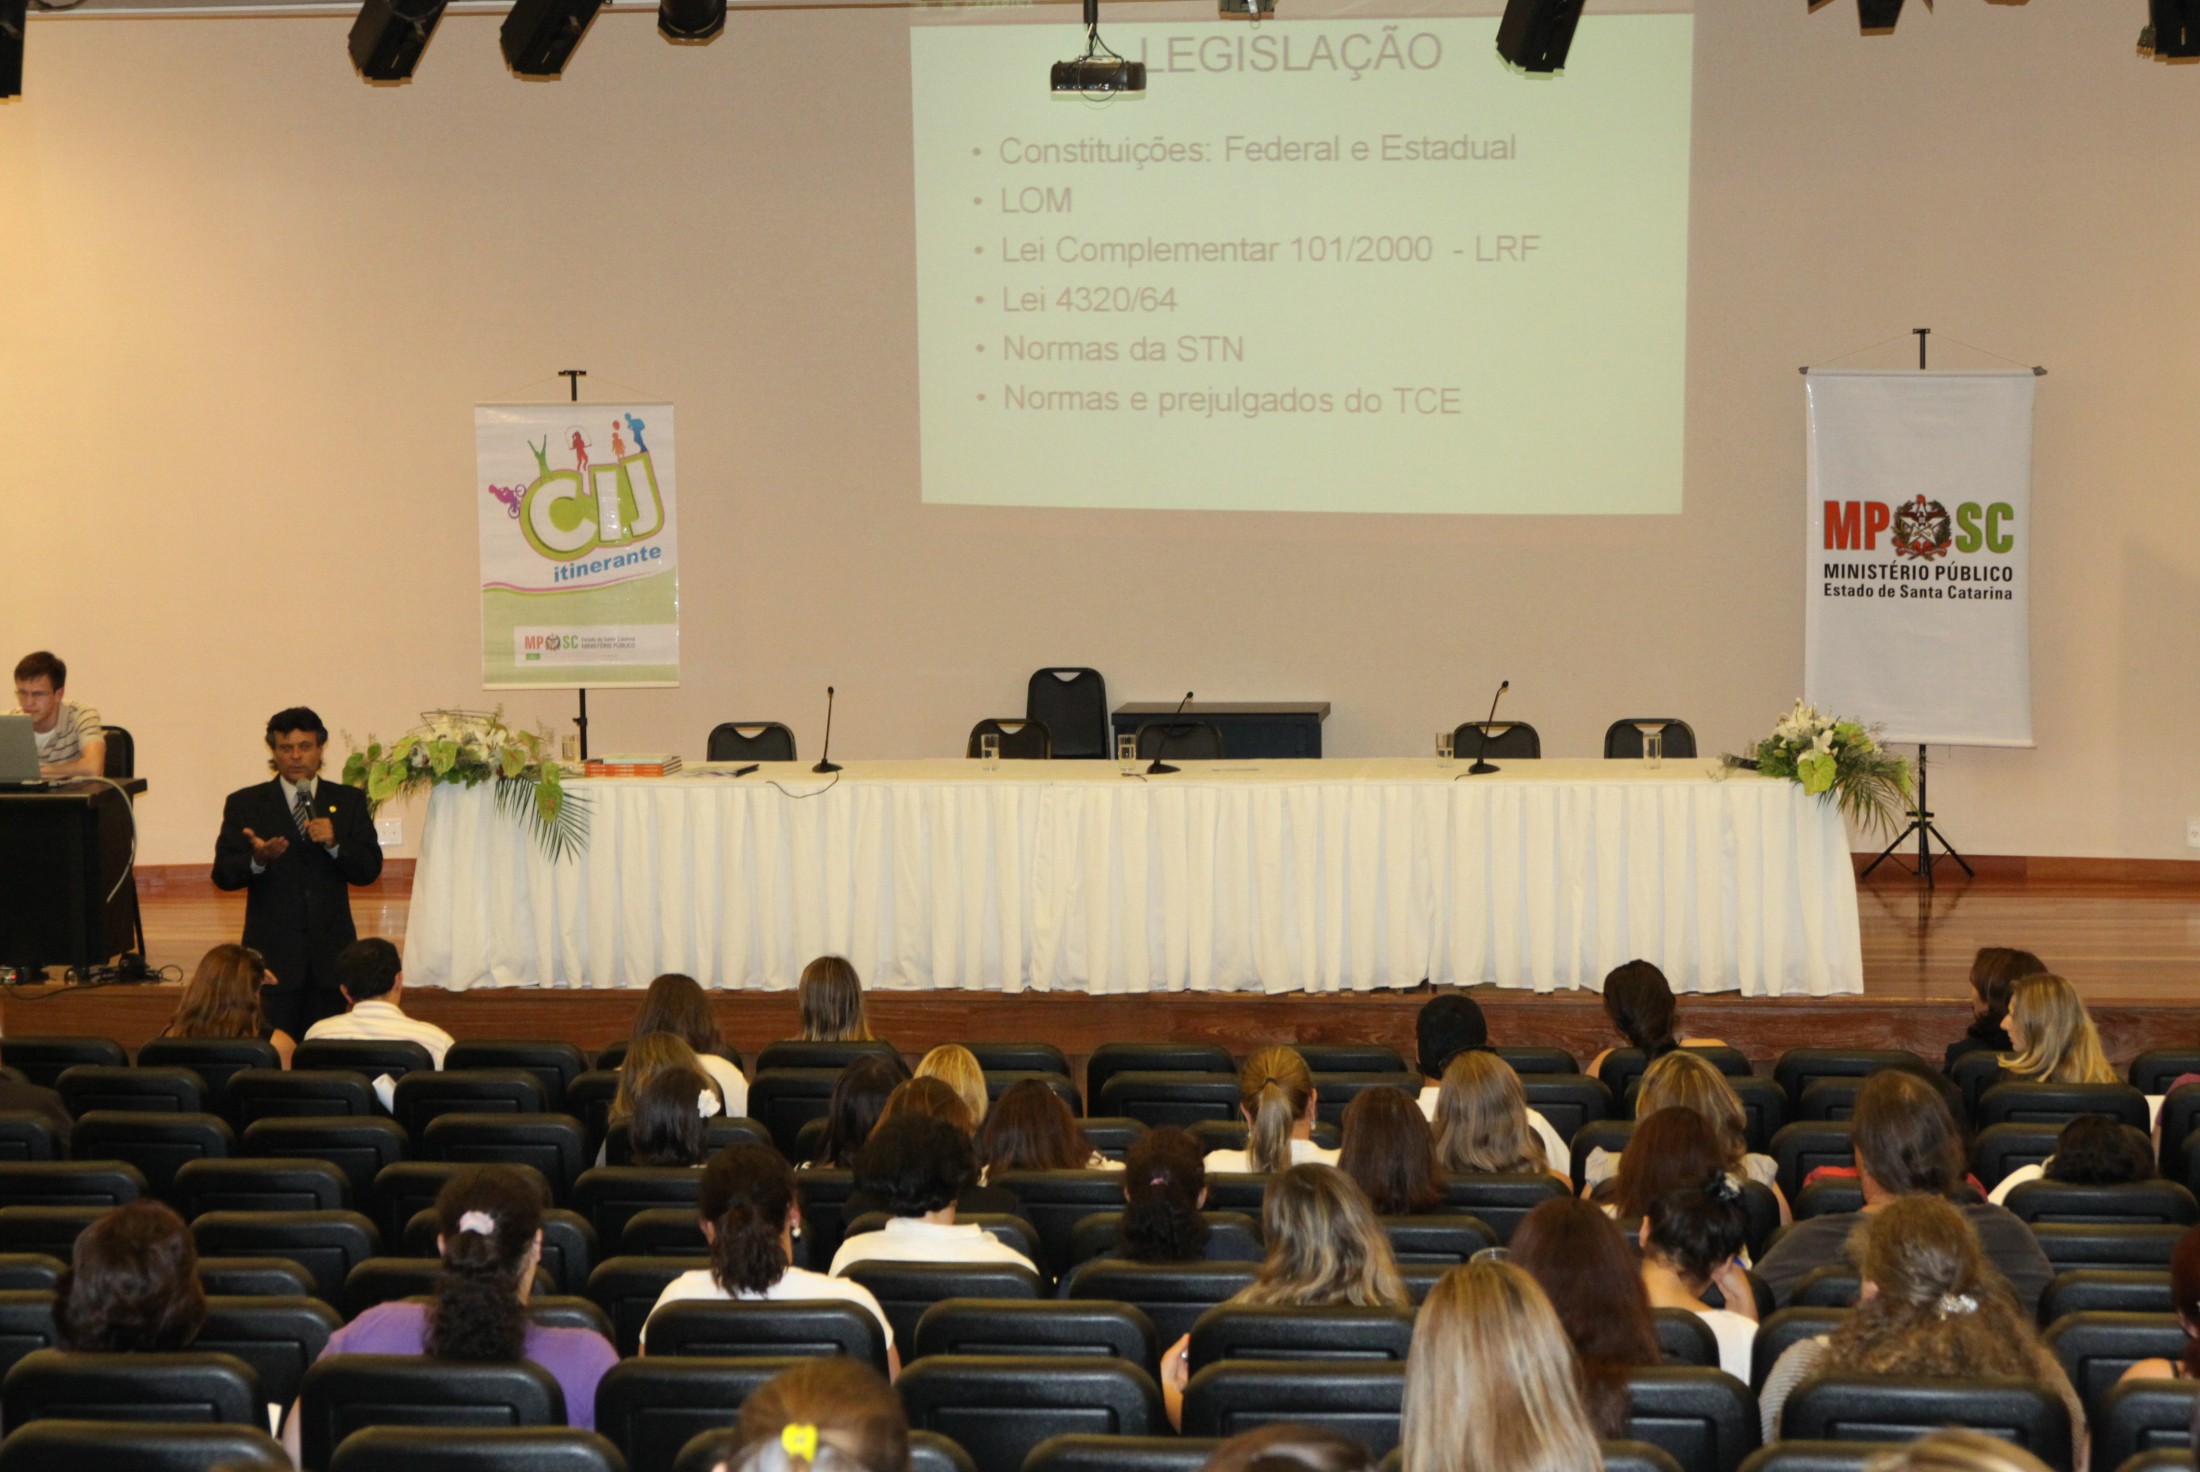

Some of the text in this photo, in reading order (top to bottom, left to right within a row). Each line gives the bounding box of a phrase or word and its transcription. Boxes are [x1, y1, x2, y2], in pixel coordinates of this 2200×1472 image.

[1141, 27, 1442, 80] LEGISLAÇÃO
[1000, 134, 1517, 169] Constituições: Federal e Estadual
[1002, 187, 1072, 214] LOM
[1003, 237, 1045, 263] Lei
[1056, 236, 1279, 268] Complementar
[1292, 236, 1433, 262] 101/2000
[1476, 235, 1541, 262] LRF
[1003, 287, 1178, 313] Lei 4320/64
[1004, 336, 1244, 363] Normas da STN
[1004, 385, 1461, 419] Normas e prejulgados do TCE
[526, 455, 661, 556] CIJ
[1823, 500, 2014, 554] MP SC
[554, 546, 661, 583] itinerante
[1824, 559, 2013, 582] MINISTÉRIO PÚBLICO
[1824, 583, 2013, 600] Estado de Santa Catarina
